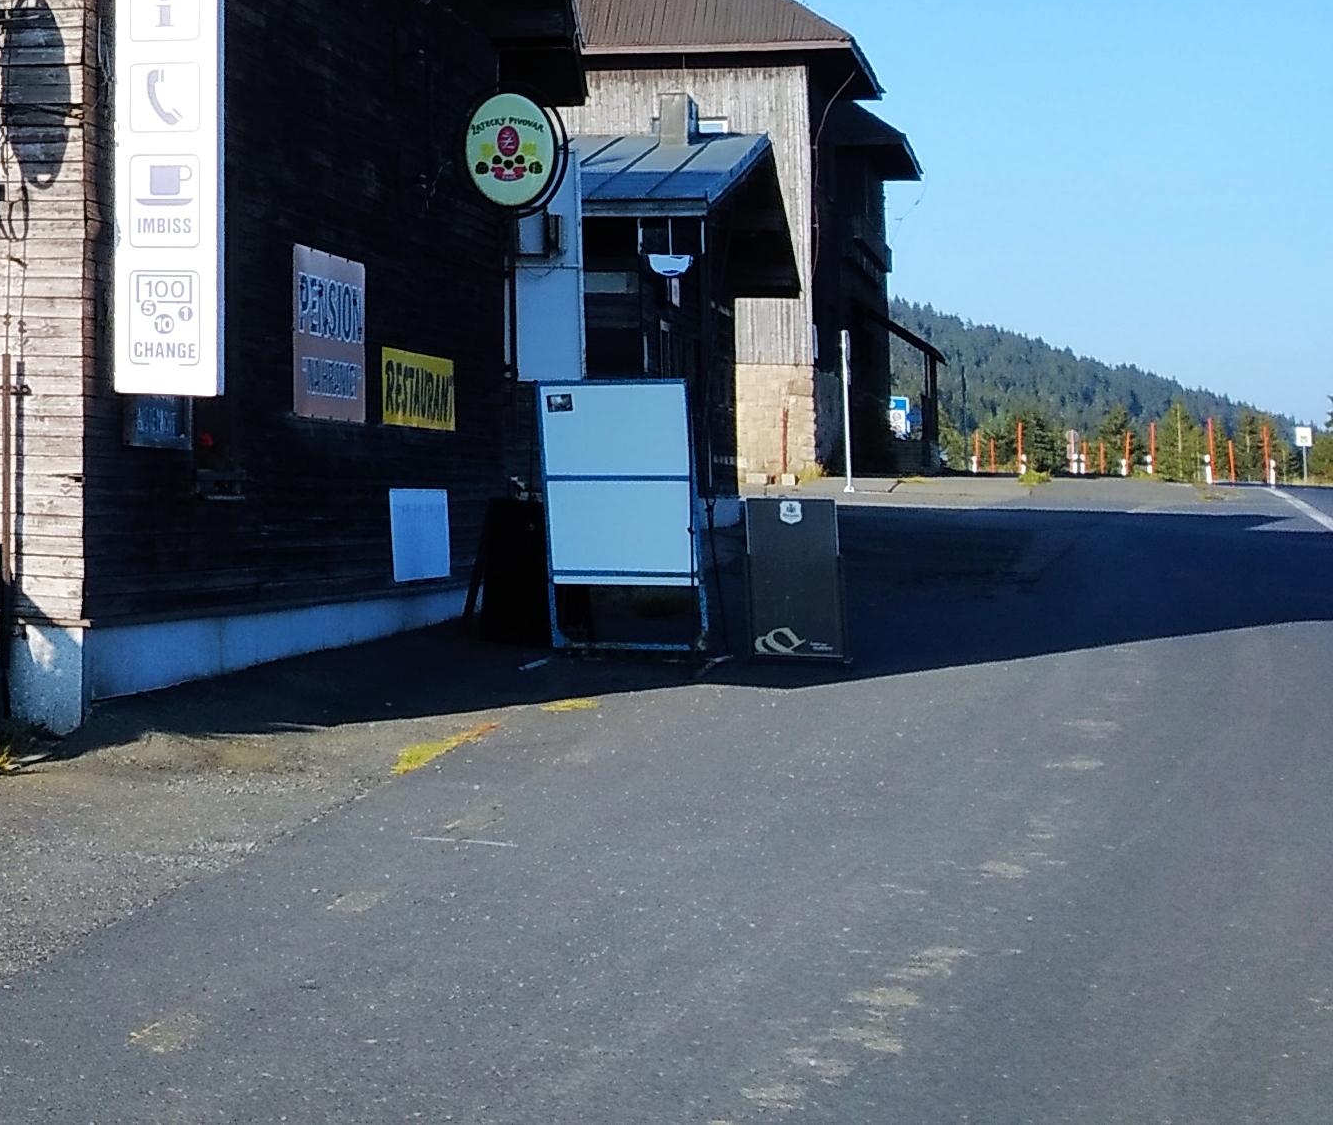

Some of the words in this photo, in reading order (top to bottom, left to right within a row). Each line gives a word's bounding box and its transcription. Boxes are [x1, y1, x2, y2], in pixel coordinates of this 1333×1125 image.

[508, 116, 545, 134] PIVOVAR
[137, 217, 192, 234] IMBISS
[144, 280, 185, 298] 100
[298, 272, 363, 344] PENSION
[134, 342, 196, 359] CHANGE
[385, 359, 454, 423] RESTAURANT
